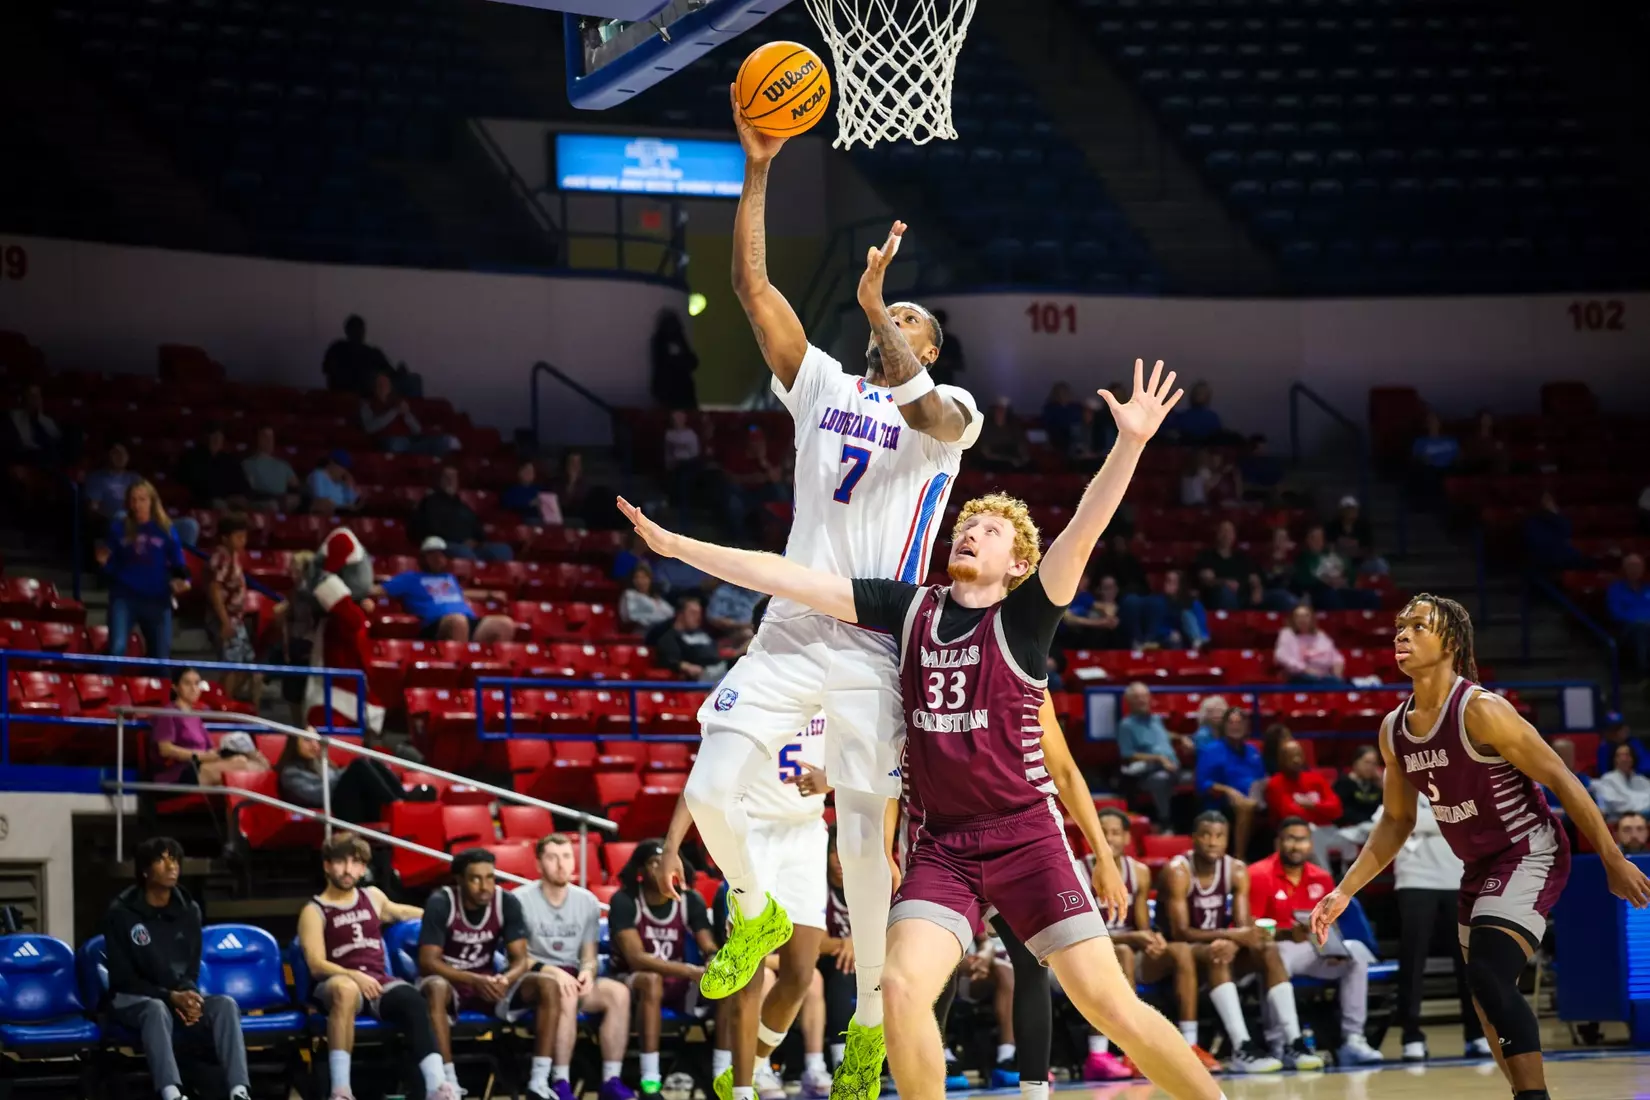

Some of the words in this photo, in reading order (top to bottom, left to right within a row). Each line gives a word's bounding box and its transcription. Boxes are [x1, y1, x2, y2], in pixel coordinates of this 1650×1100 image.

[763, 59, 817, 102] Wilson
[791, 85, 826, 120] NCAA
[1025, 301, 1077, 334] 101
[1567, 300, 1625, 332] 102
[833, 444, 872, 504] 7
[926, 670, 967, 709] 33
[912, 708, 988, 733] CRISTIAN
[779, 743, 802, 784] 5
[1403, 748, 1449, 773] DALLAS
[1056, 889, 1085, 912] D
[351, 922, 364, 943] 3
